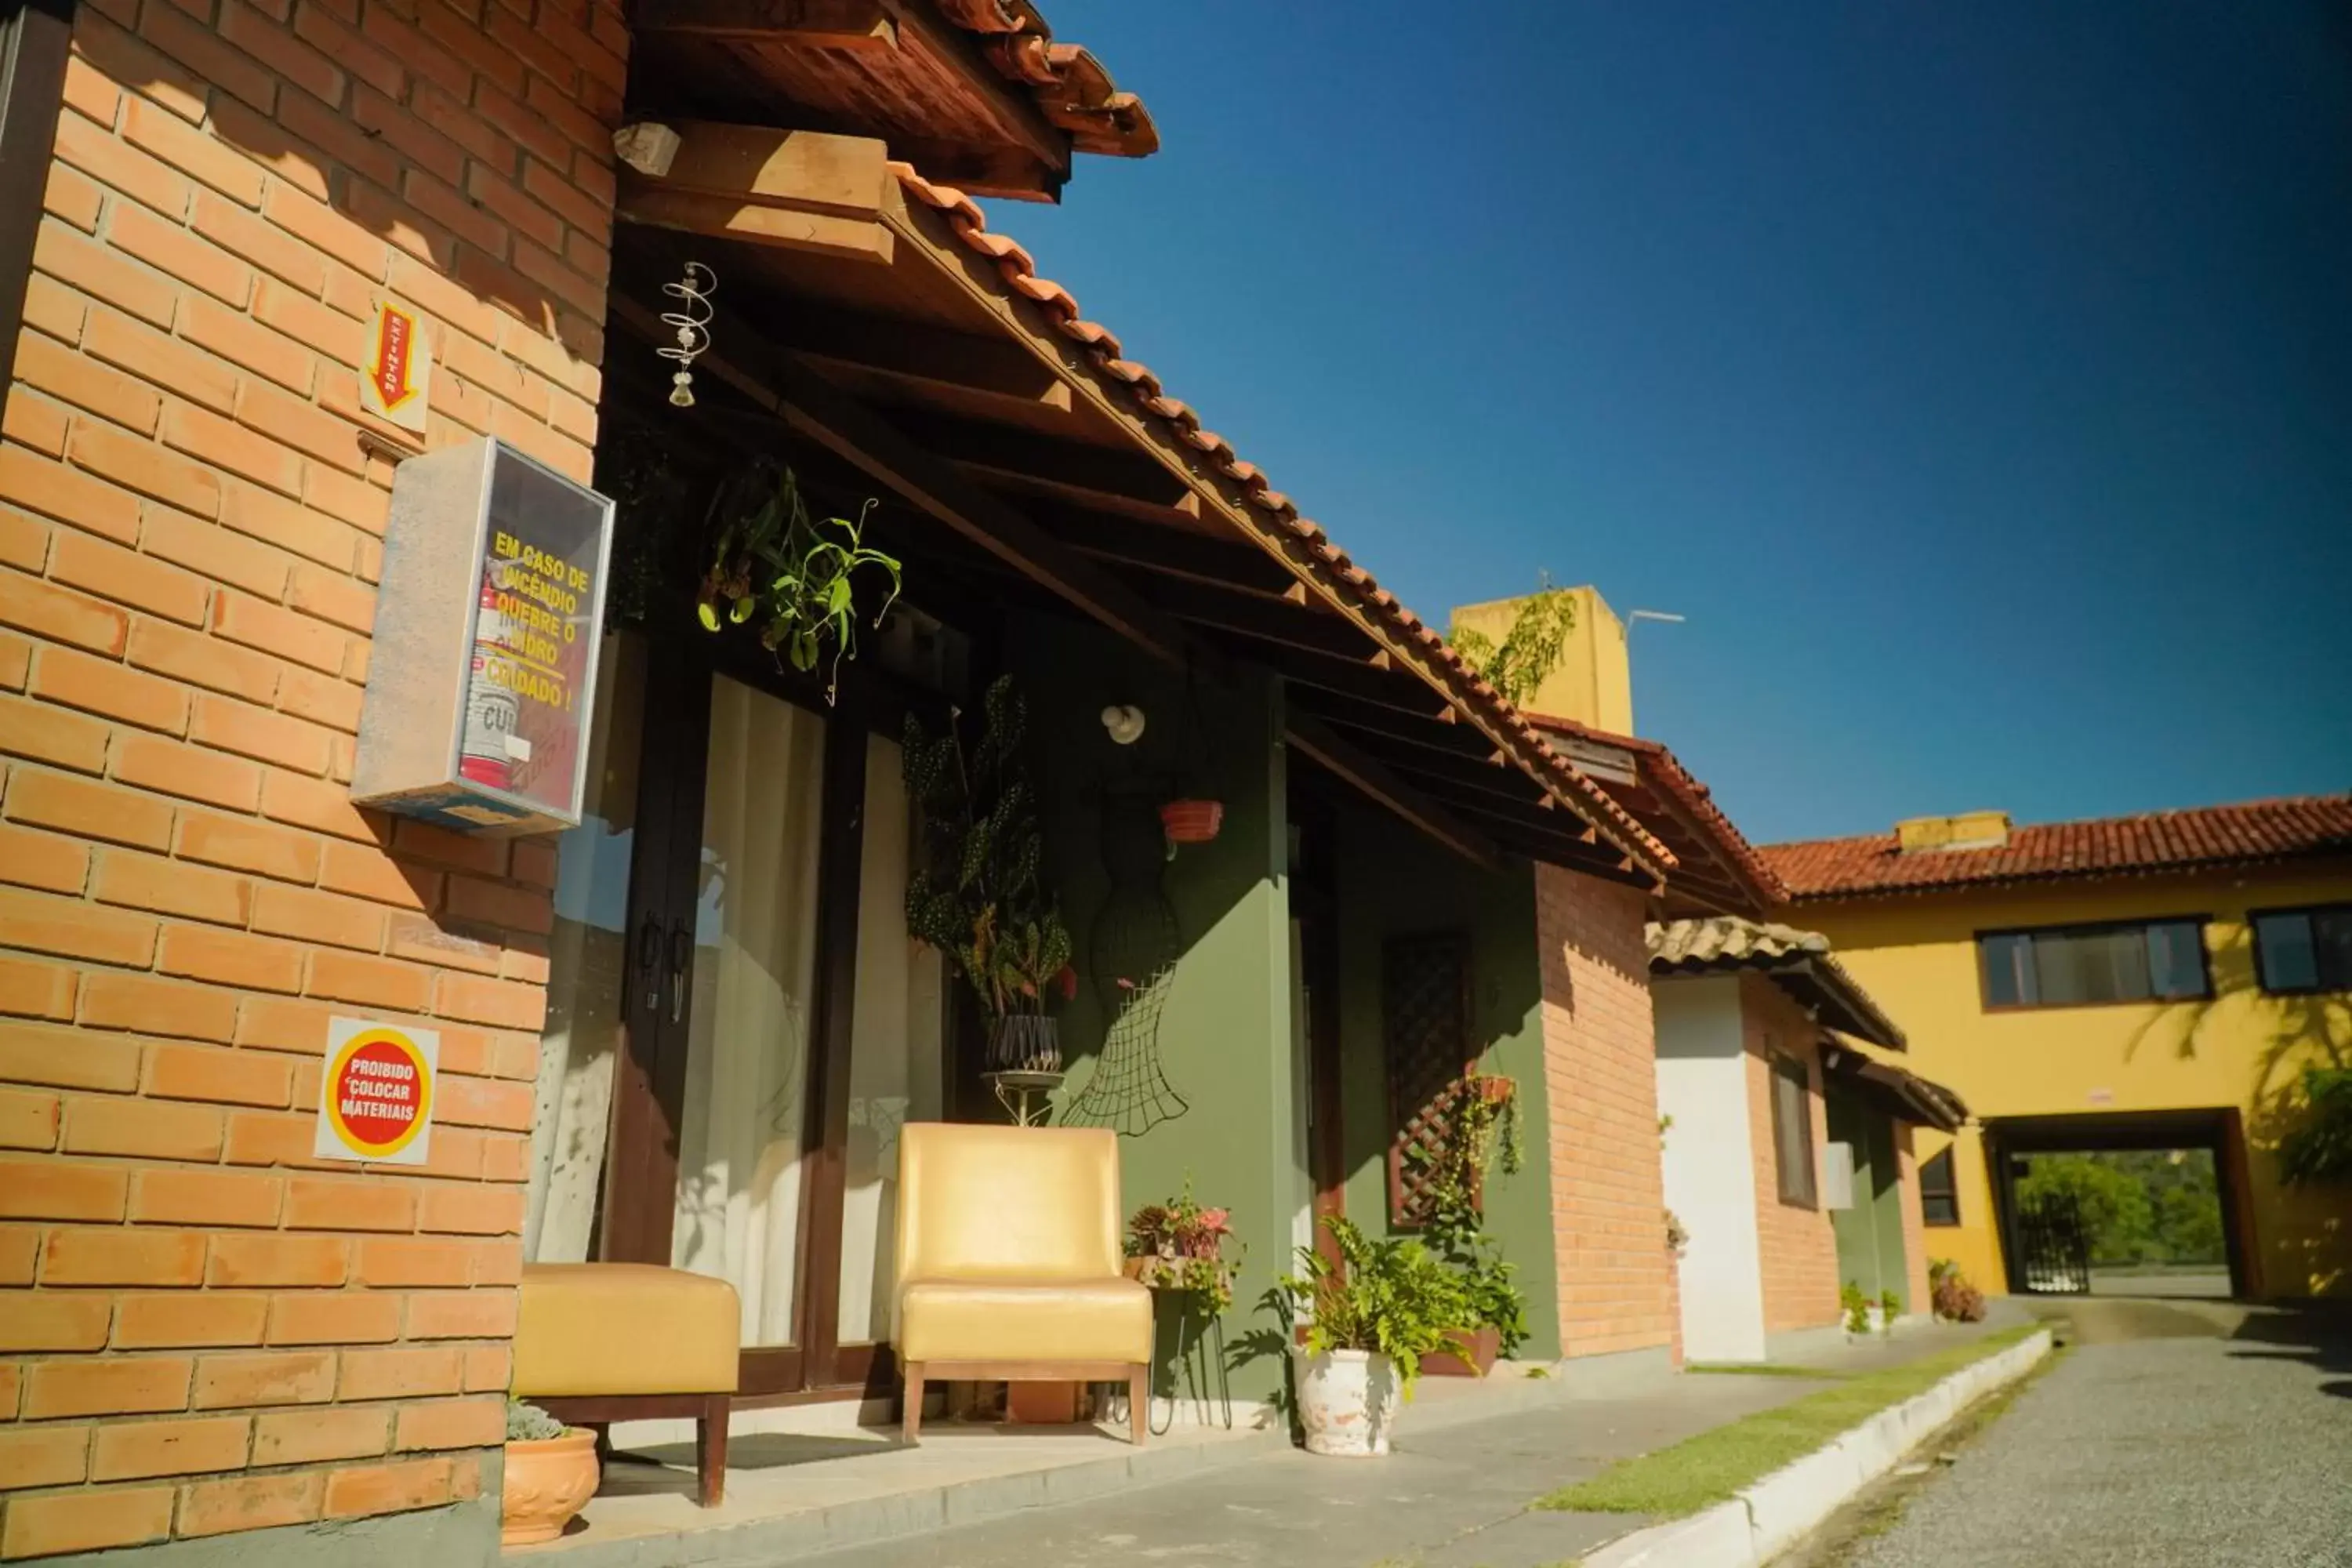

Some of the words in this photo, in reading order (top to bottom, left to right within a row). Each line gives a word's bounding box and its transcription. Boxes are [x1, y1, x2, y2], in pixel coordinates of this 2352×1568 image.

[384, 315, 402, 393] EXTINTOR
[495, 531, 520, 560] EM
[523, 545, 565, 582] CASO
[568, 566, 589, 593] DE
[503, 564, 576, 615] INCÊNDIO
[496, 592, 561, 637] QUEBRE
[564, 623, 575, 644] O
[350, 1058, 413, 1080] PROIBIDO
[350, 1079, 410, 1101] COLOCAR
[341, 1098, 415, 1121] MATERIAIS
